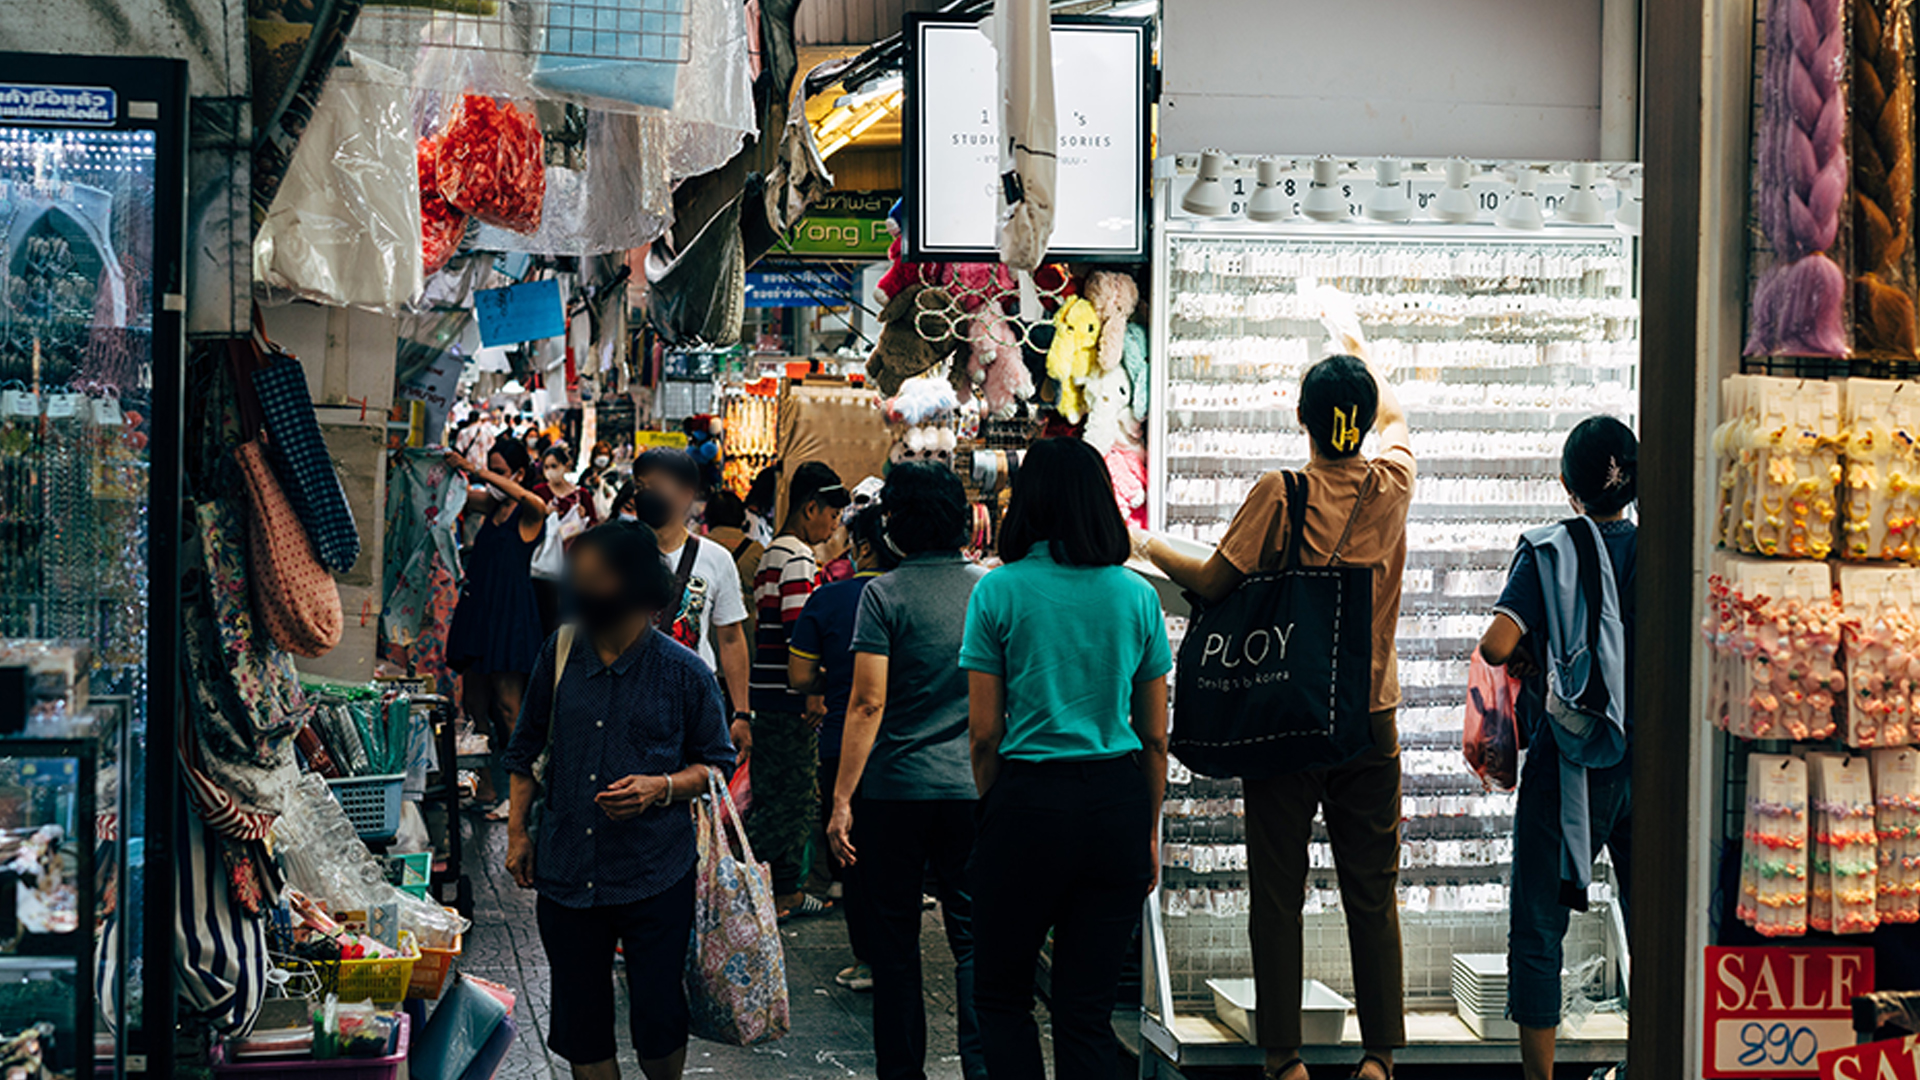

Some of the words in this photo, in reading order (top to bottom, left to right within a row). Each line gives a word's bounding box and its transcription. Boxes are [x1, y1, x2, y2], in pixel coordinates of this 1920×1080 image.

[952, 134, 1001, 146] STUDI
[793, 219, 860, 247] Yong
[1201, 622, 1295, 668] PLOY
[1716, 953, 1862, 1012] SALE
[1737, 1022, 1819, 1066] 890
